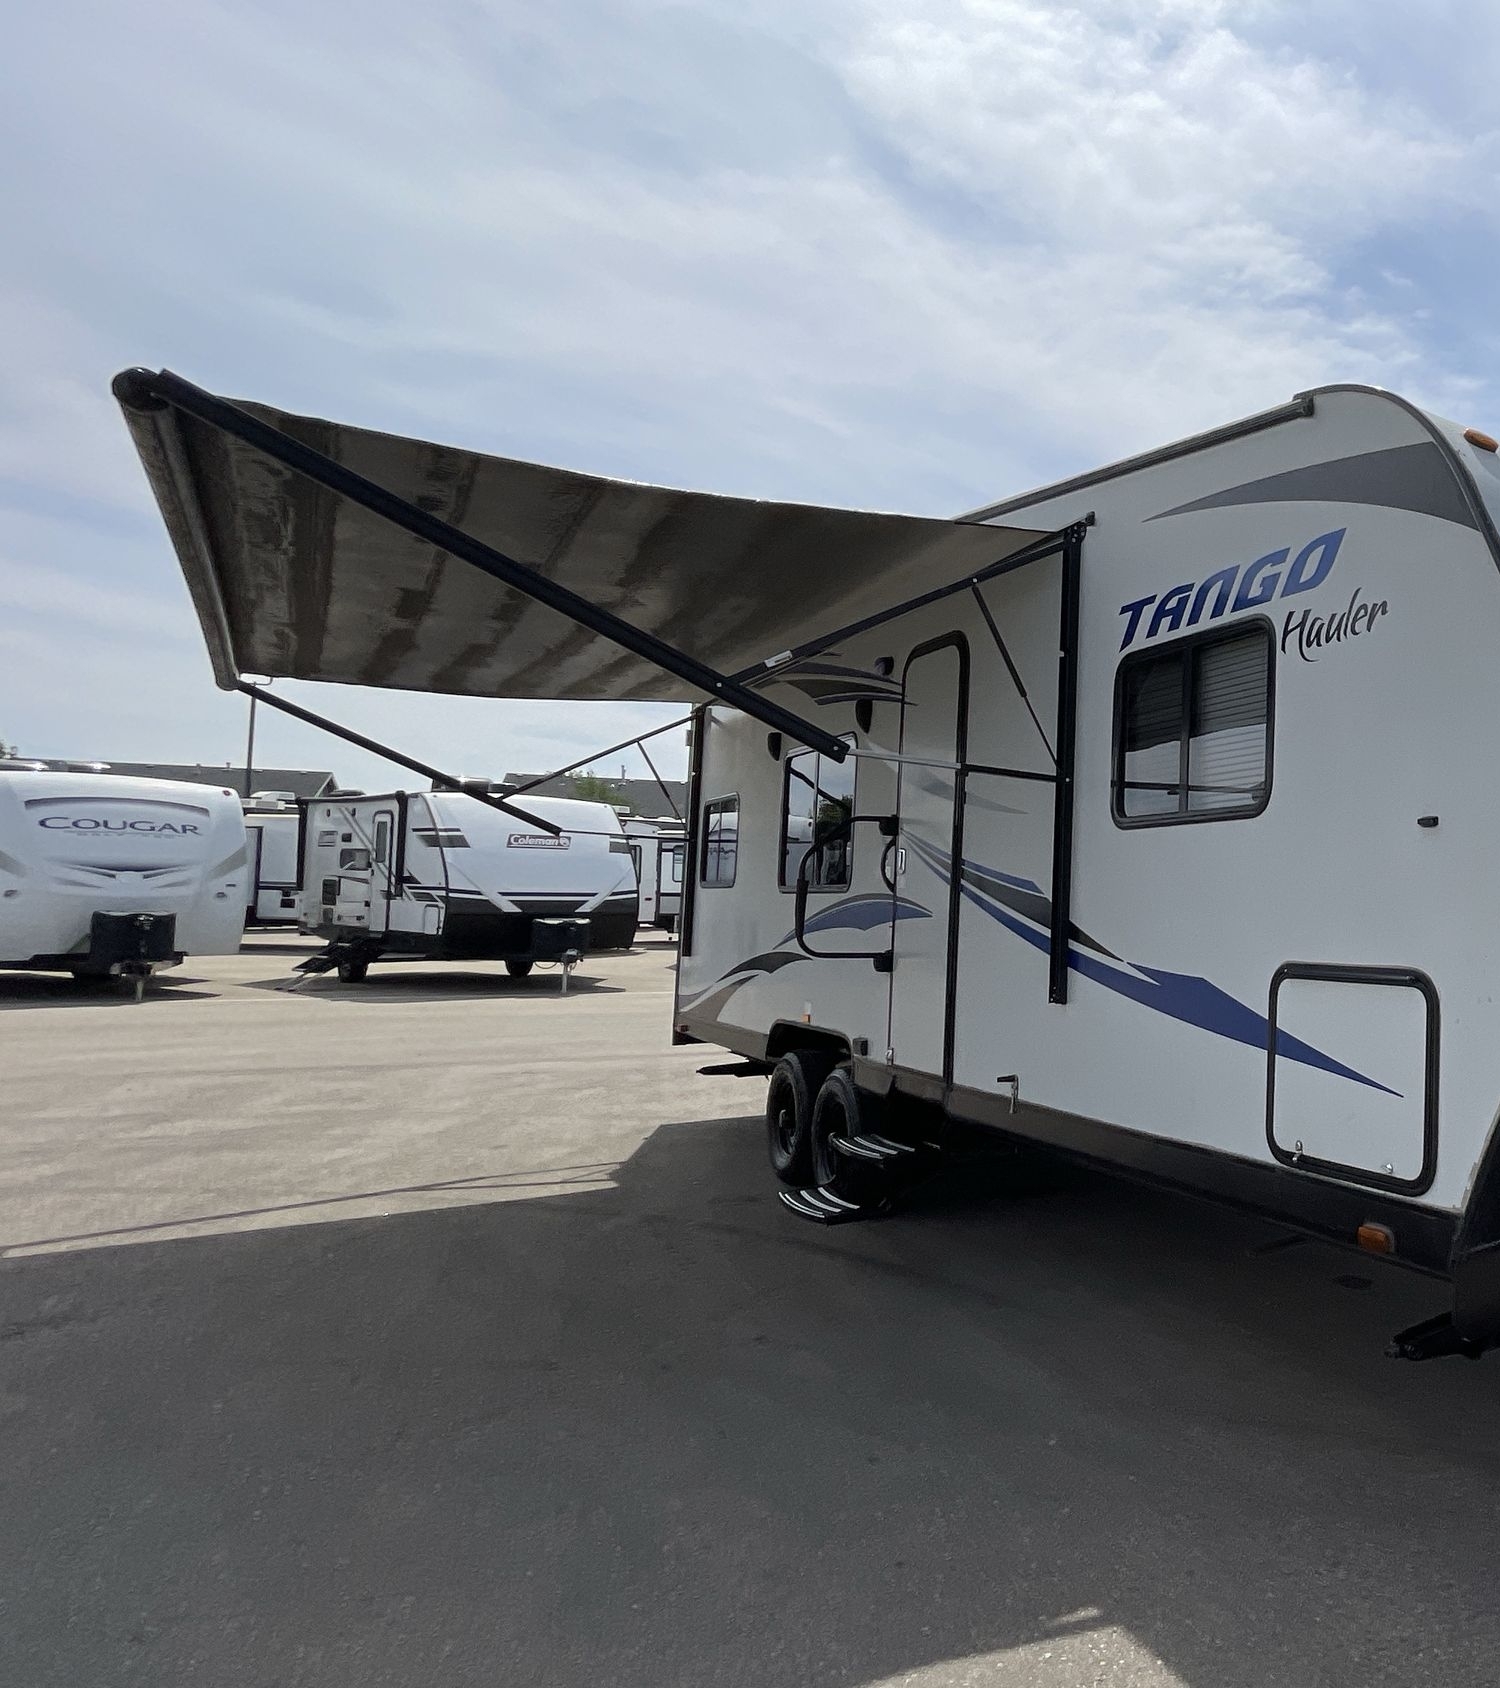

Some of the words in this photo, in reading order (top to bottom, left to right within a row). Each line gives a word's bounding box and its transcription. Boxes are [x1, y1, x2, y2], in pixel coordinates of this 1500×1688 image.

[1118, 527, 1347, 653] TANGO
[1280, 587, 1389, 662] Hauler
[38, 816, 202, 835] COUGAR
[510, 834, 559, 846] Coleman
